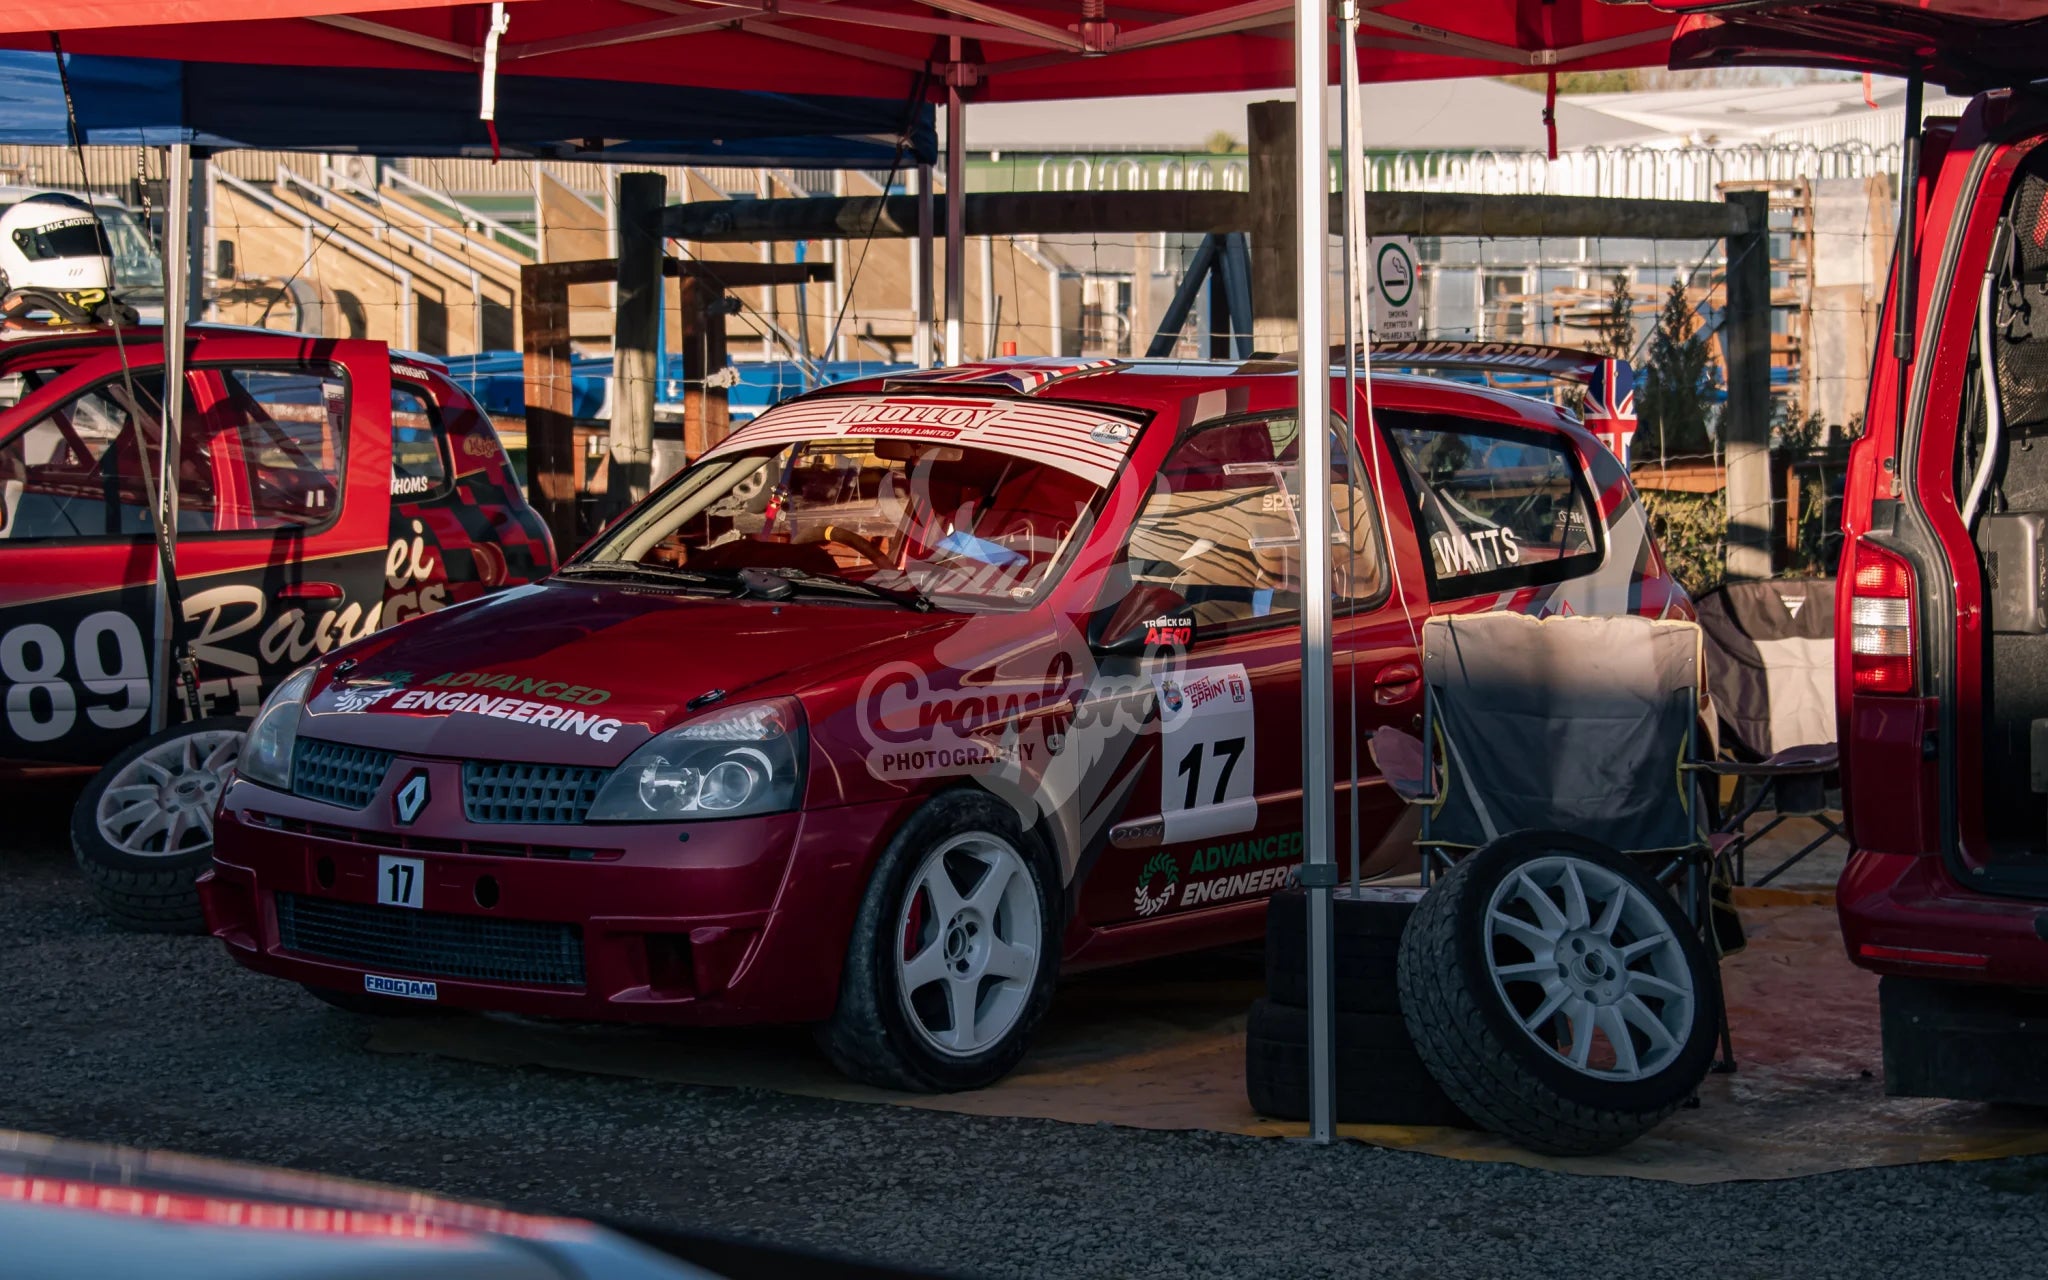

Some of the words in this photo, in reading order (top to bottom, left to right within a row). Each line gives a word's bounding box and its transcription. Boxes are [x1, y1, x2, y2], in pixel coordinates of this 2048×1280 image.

[47, 221, 65, 232] HJC
[391, 364, 429, 380] WRIGHT
[836, 404, 1007, 430] MOLLOY
[850, 426, 914, 435] AGRICULTURE
[915, 428, 956, 438] LIMITED
[1434, 526, 1519, 573] WATTS
[1142, 615, 1178, 628] TRCK
[1178, 618, 1192, 627] CAR
[1, 610, 152, 742] 89
[422, 672, 612, 706] ADVANCED
[1183, 676, 1211, 697] STREET
[1190, 679, 1227, 709] SPRINT
[392, 691, 623, 743] ENGINEERING
[1177, 737, 1246, 810] 17
[1189, 831, 1303, 875] ADVANCED
[387, 864, 415, 904] 17
[1180, 865, 1300, 907] ENGINEER
[366, 976, 436, 996] FROGJAM
